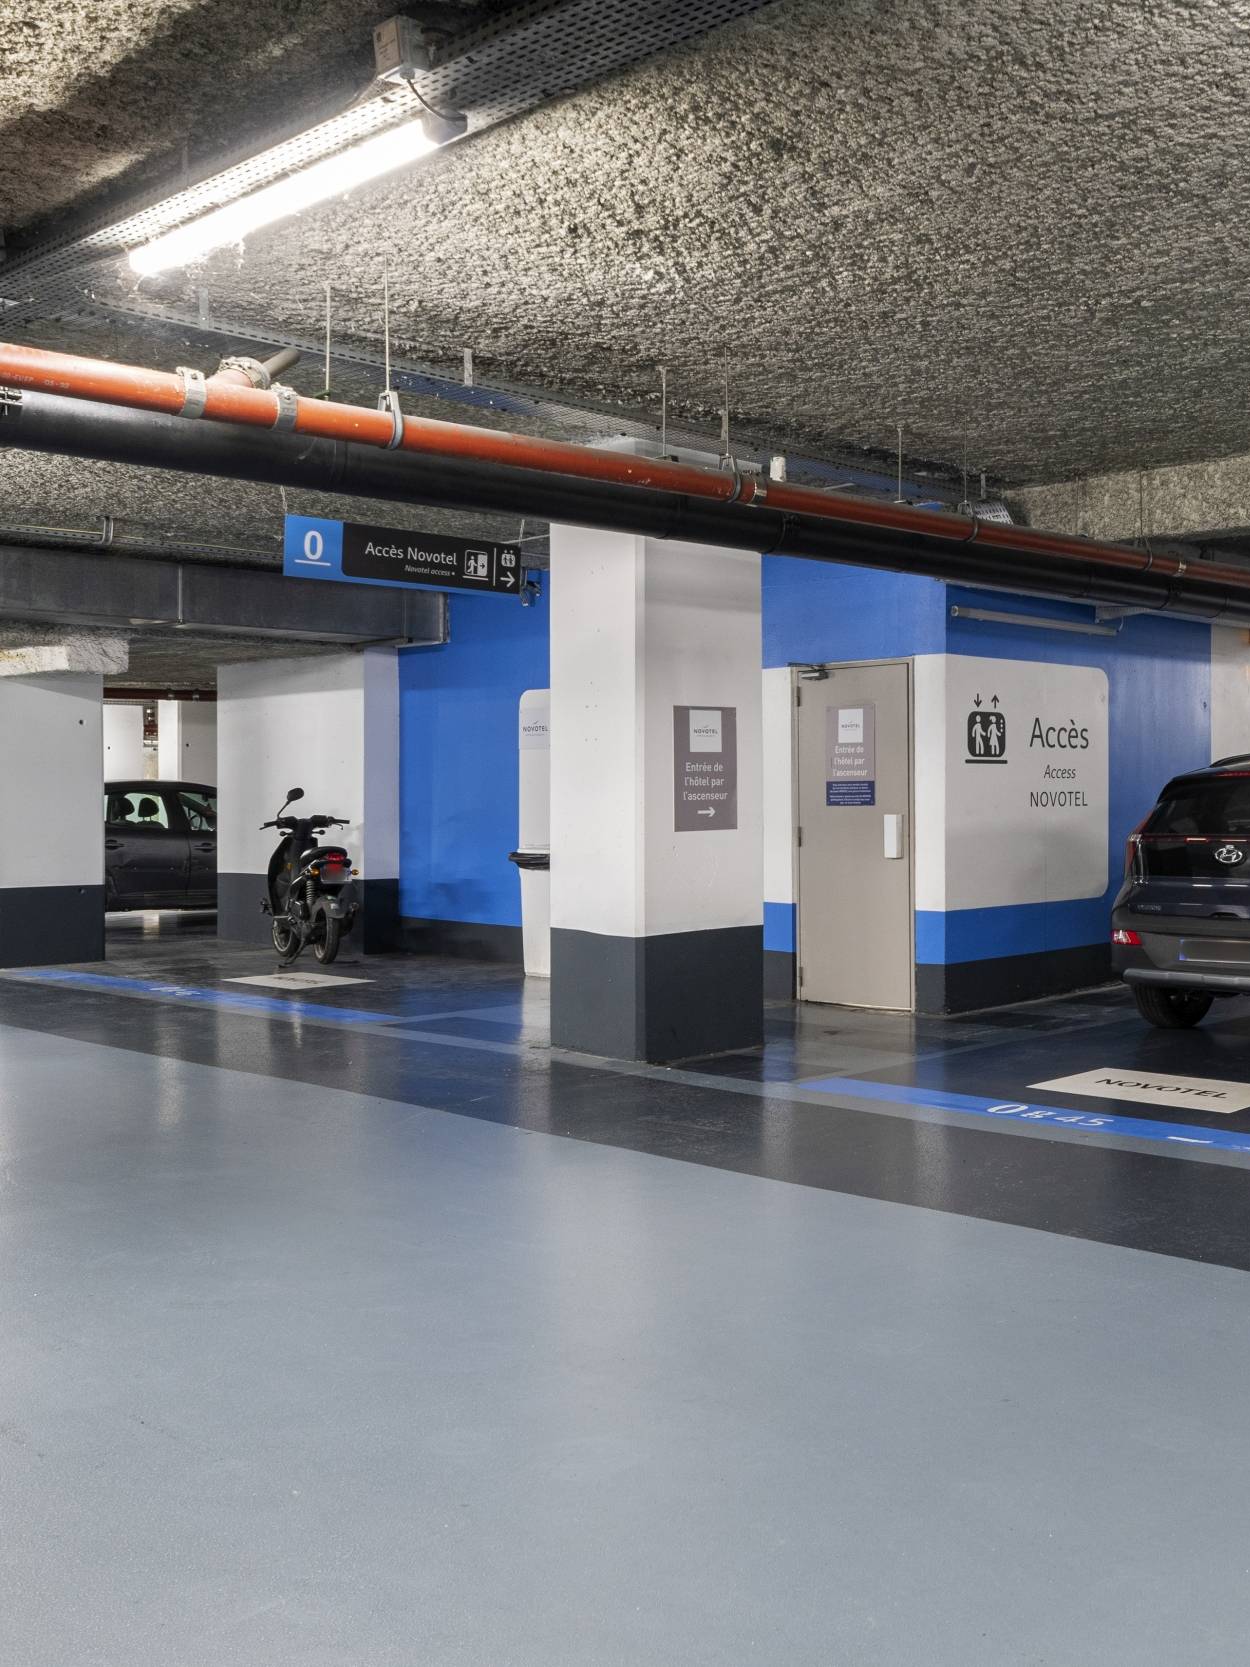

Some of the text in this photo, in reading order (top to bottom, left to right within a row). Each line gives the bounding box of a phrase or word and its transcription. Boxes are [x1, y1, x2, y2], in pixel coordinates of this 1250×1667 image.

[303, 530, 324, 560] 0
[365, 542, 457, 565] Accès Novotel
[404, 564, 451, 577] Novotel access
[1029, 717, 1089, 749] Accès
[834, 745, 865, 754] Entrée de
[685, 761, 724, 772] Entrée de
[854, 757, 865, 766] par
[1044, 764, 1076, 779] Access
[684, 776, 725, 789] l'hôtel par
[683, 791, 729, 801] l'ascenseur
[1030, 791, 1088, 807] NOVOTEL
[1095, 1078, 1228, 1099] NOVOTEL
[986, 1104, 1115, 1127] 0845
